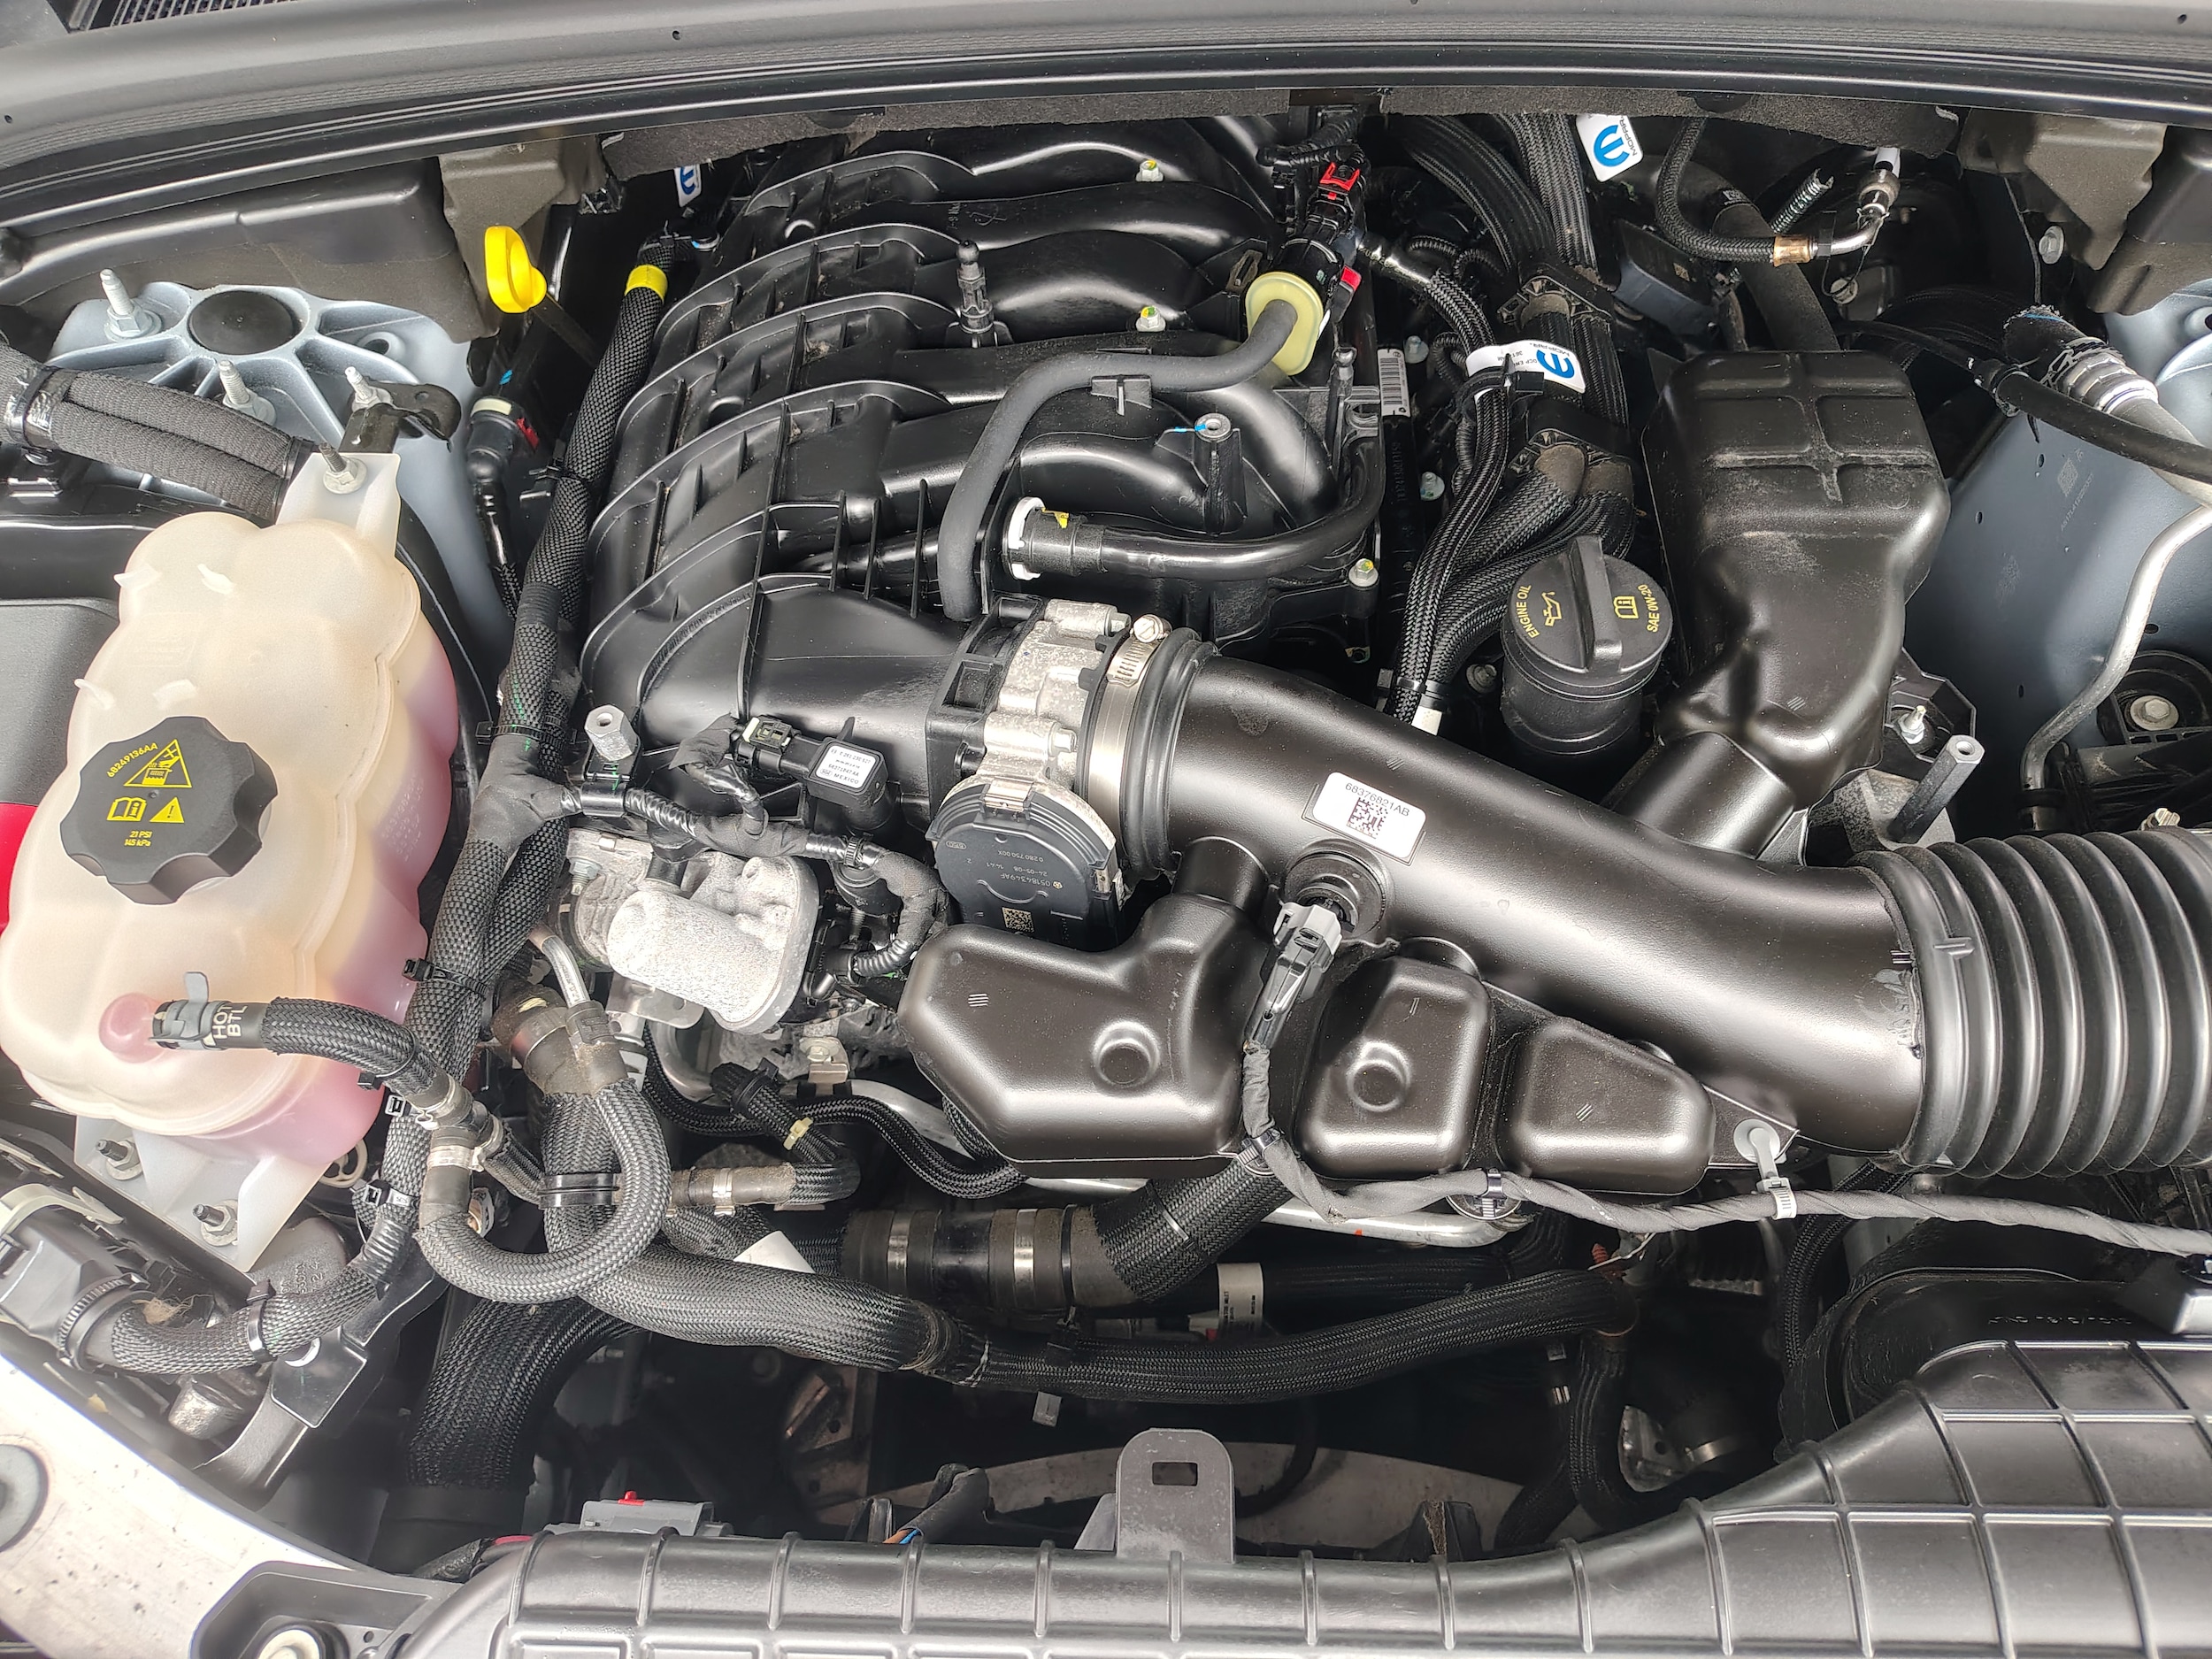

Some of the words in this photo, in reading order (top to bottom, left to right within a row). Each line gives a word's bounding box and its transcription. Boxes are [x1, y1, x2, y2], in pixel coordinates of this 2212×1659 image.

[1517, 585, 1532, 600] OIL
[1637, 584, 1659, 611] 0W-20
[1516, 602, 1540, 639] ENGINE
[1647, 612, 1660, 633] SAE
[106, 742, 158, 778] 68249136AA
[833, 773, 860, 785] MEXICO
[1345, 782, 1410, 817] 68376821AB
[1000, 872, 1051, 887] 05184349AF
[1013, 865, 1048, 877] 24-05-08
[212, 1005, 233, 1039] HOT
[227, 1005, 248, 1037] BTL
